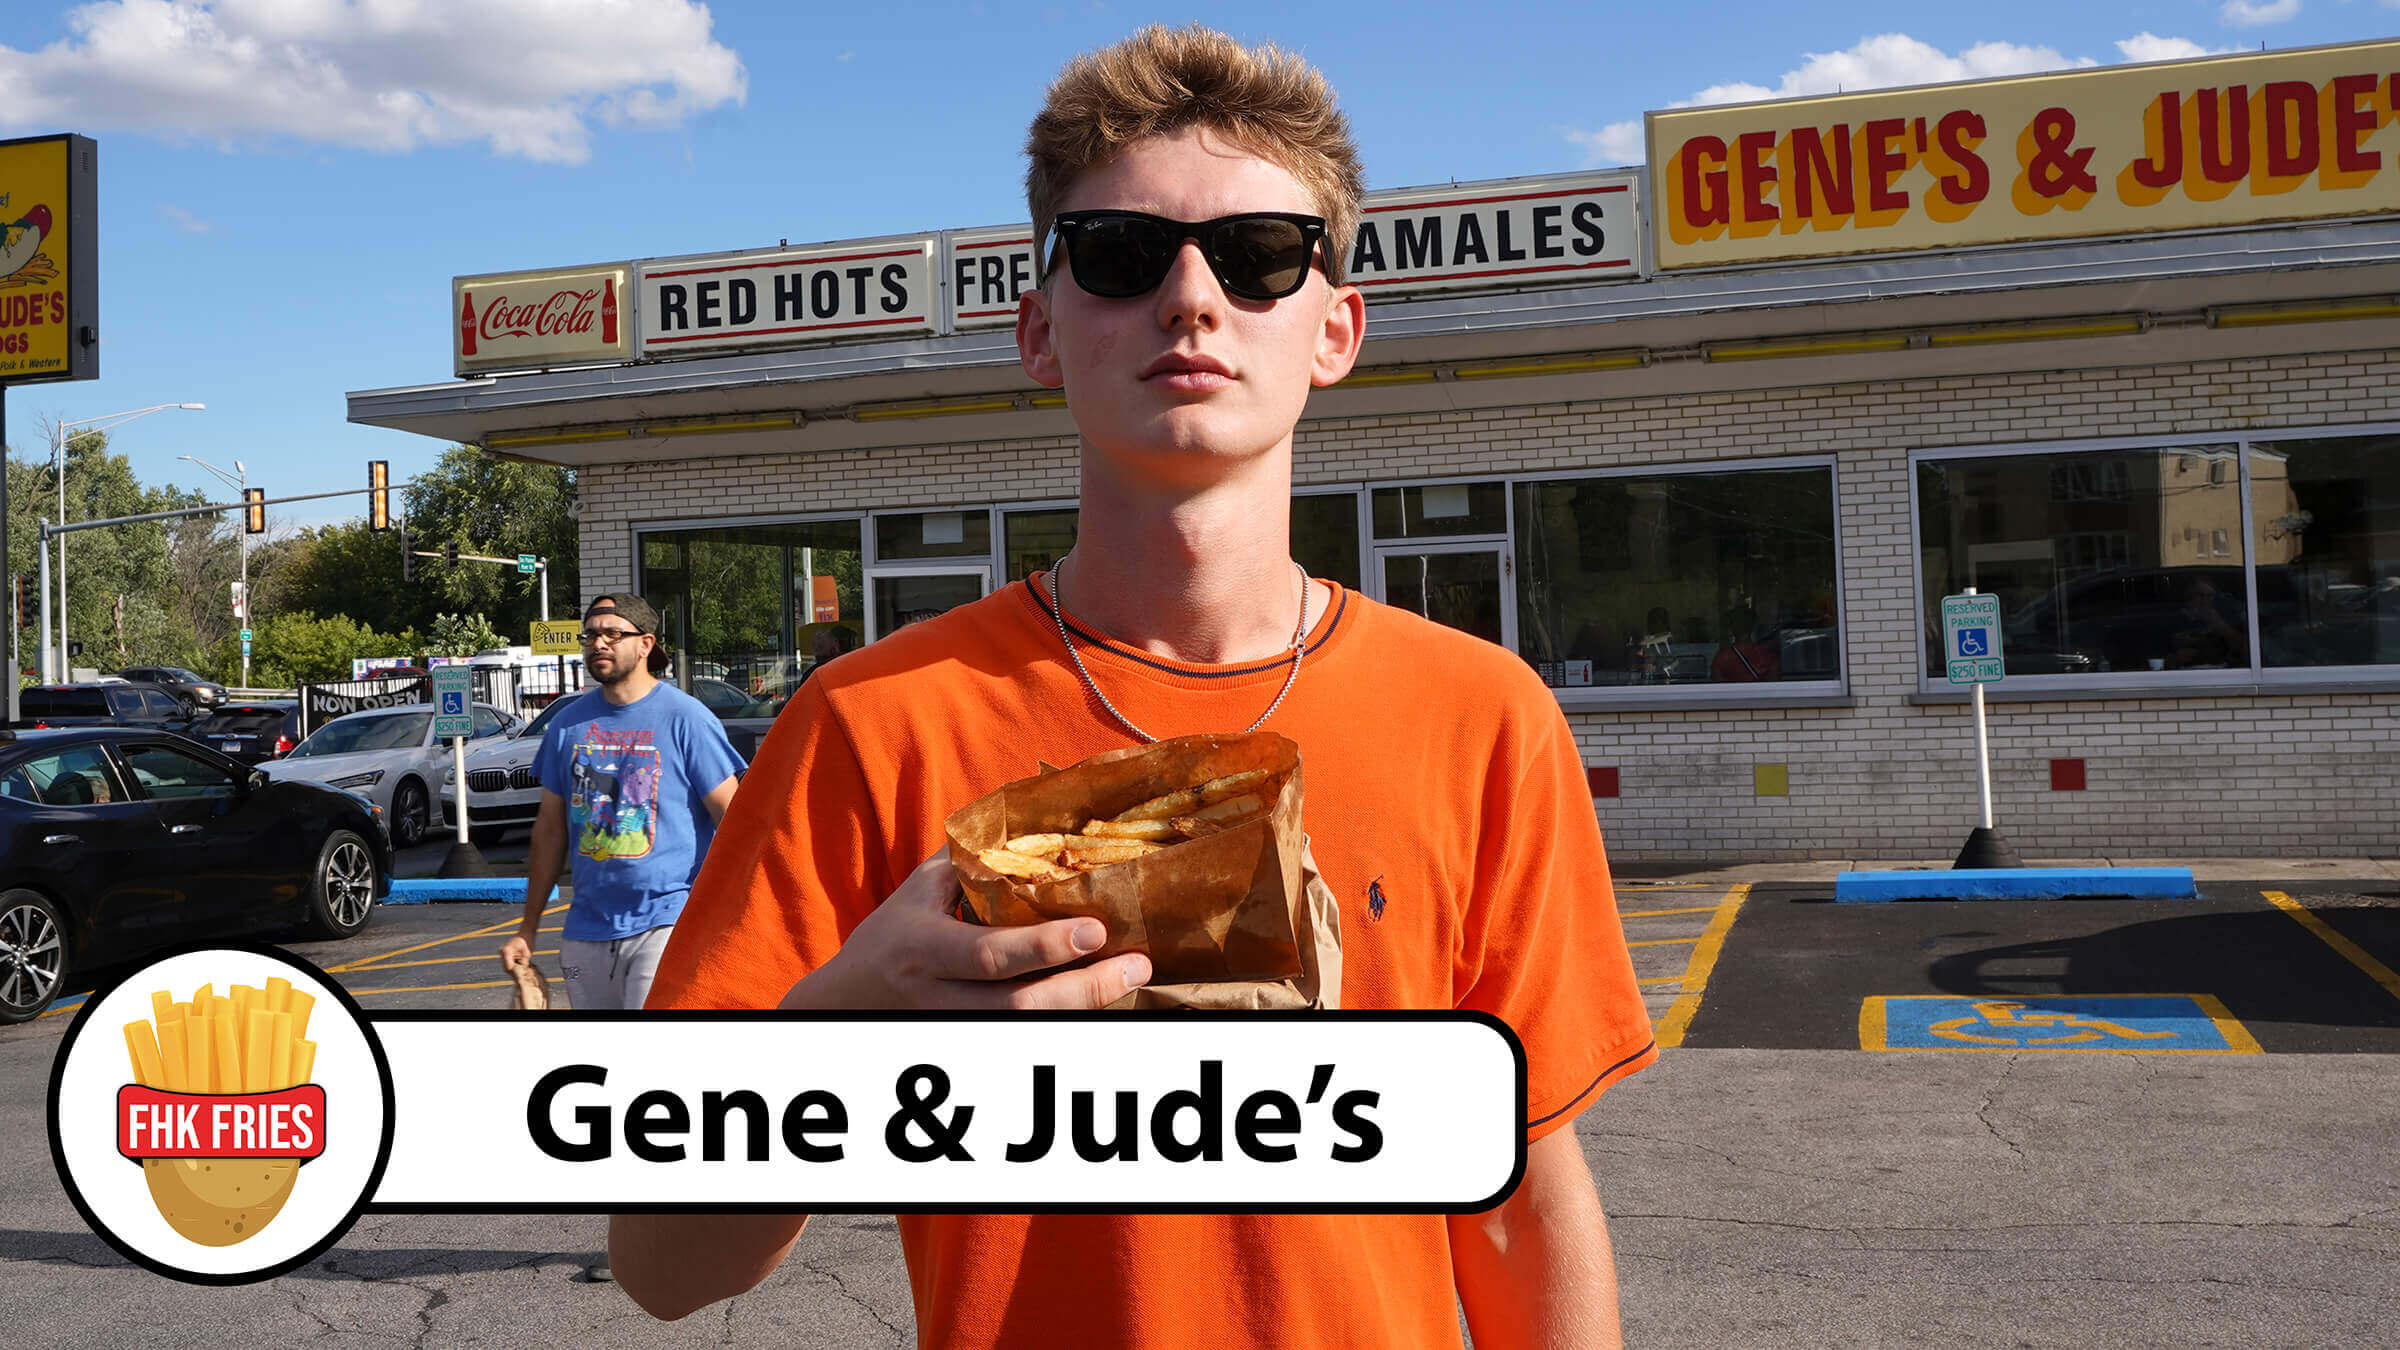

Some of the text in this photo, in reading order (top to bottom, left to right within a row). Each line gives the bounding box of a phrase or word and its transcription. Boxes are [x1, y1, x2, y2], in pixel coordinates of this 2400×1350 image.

[1675, 73, 2400, 234] GENE'S & JUDE'
[0, 191, 9, 208] ef
[1351, 202, 1605, 273] AMALES
[955, 253, 1031, 306] FRE
[660, 263, 909, 332] RED HOTS
[0, 290, 65, 329] UDE'S
[480, 289, 600, 340] Coca-Cola
[0, 332, 29, 354] GS
[1946, 602, 1996, 615] RESERVED
[1951, 615, 1994, 628] PARKING
[543, 631, 572, 645] ENTER
[435, 671, 468, 681] RESERVED
[1951, 663, 2001, 679] $250 FINE
[438, 681, 467, 691] PARKING
[313, 689, 421, 714] NOW OPEN
[437, 720, 470, 732] $250 FINE
[596, 739, 652, 757] TIME
